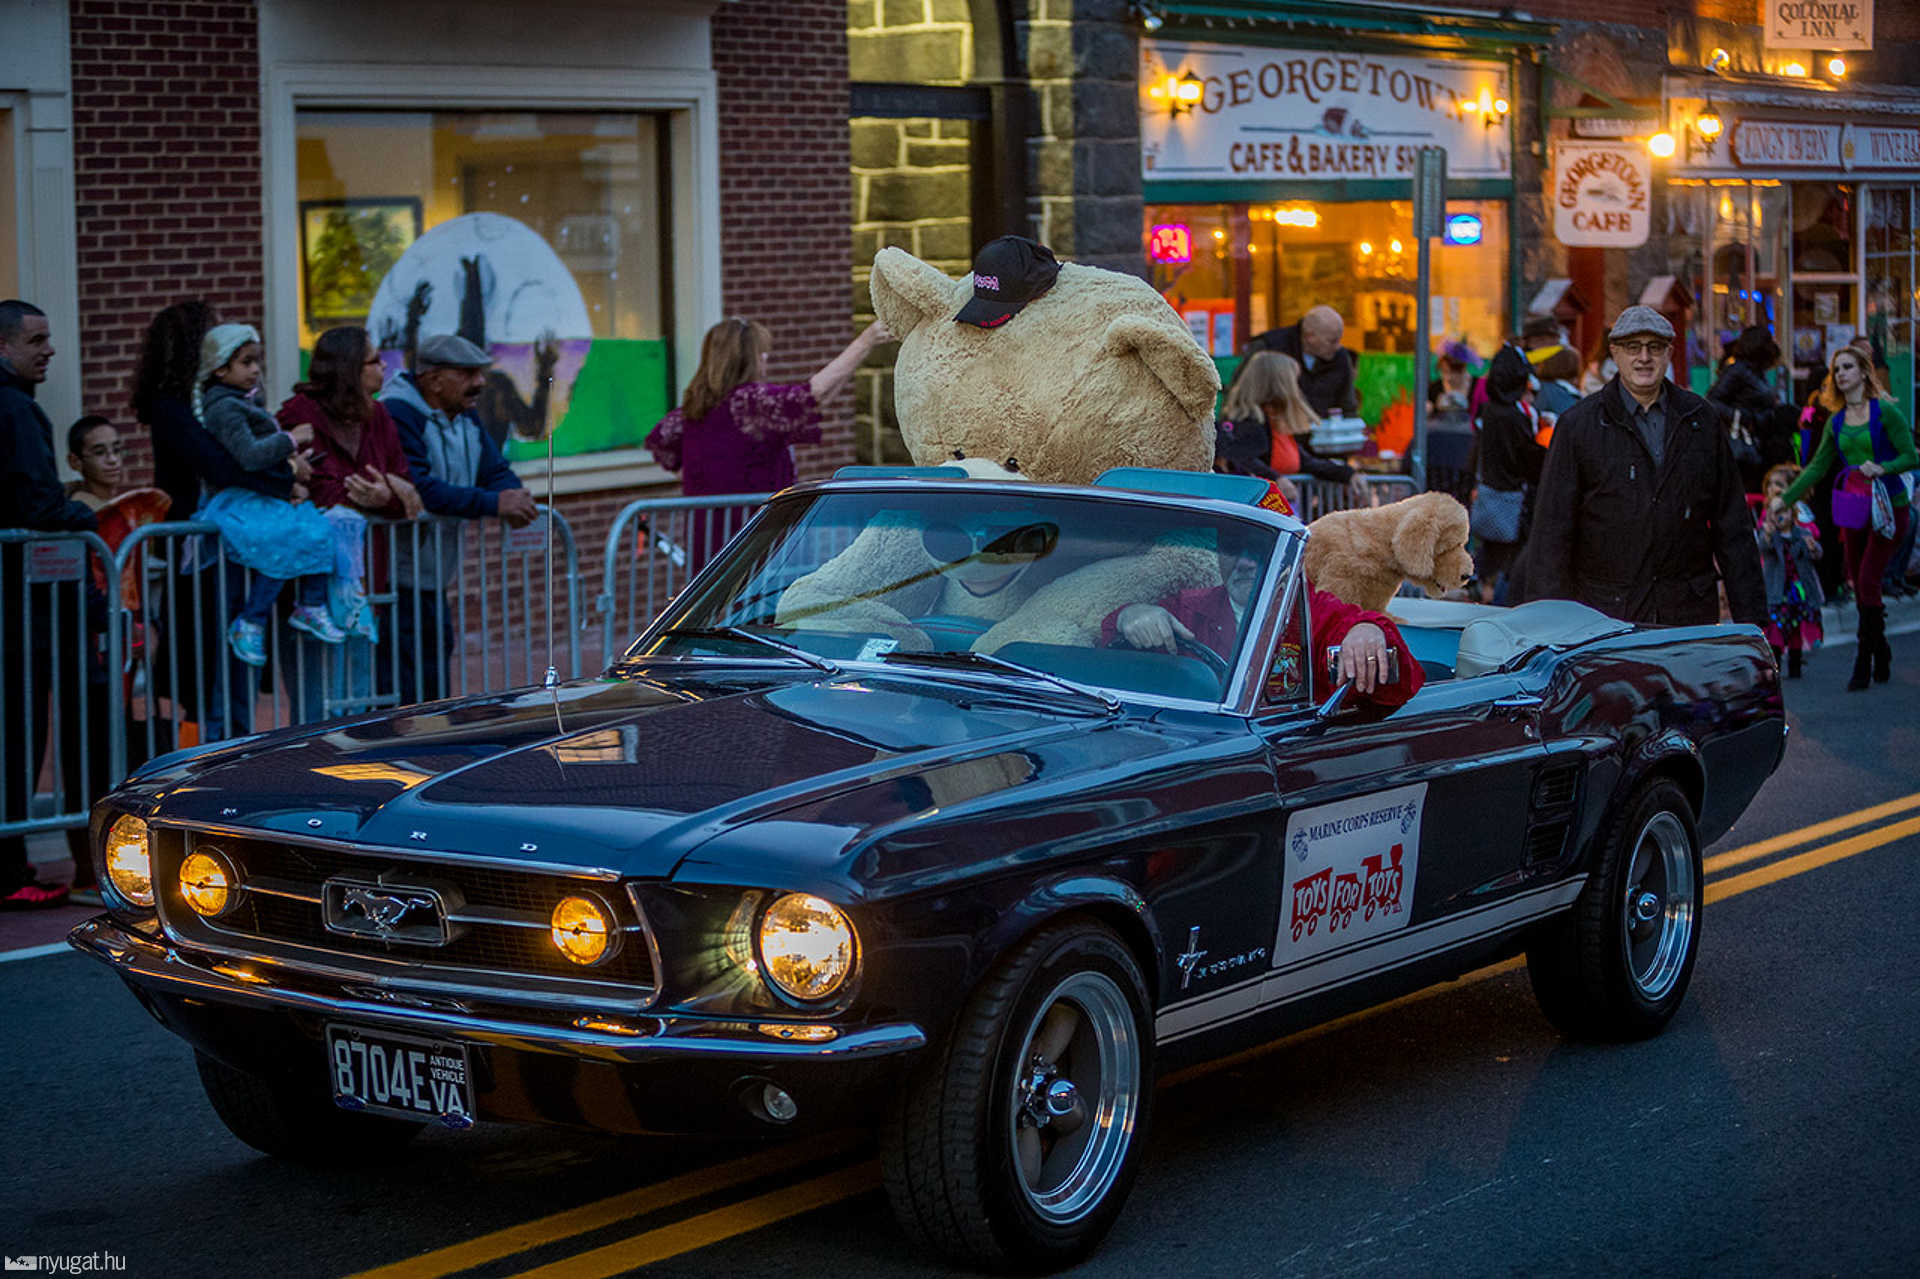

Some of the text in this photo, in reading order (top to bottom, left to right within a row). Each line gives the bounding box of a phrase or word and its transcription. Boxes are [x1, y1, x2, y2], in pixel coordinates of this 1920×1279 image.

[1779, 3, 1860, 25] COLONIAL
[1801, 21, 1836, 36] INN
[1229, 143, 1284, 174] CAFE
[1286, 134, 1307, 175] &
[1308, 143, 1389, 178] BAKERY
[1572, 211, 1632, 233] CAFE
[1309, 804, 1403, 841] MARINE CORPS RESERVE
[1295, 868, 1400, 917] TOYS FOR TOTS
[430, 1055, 465, 1071] ANTIQUE
[334, 1039, 432, 1111] 8704E
[431, 1068, 466, 1085] VEHICLE
